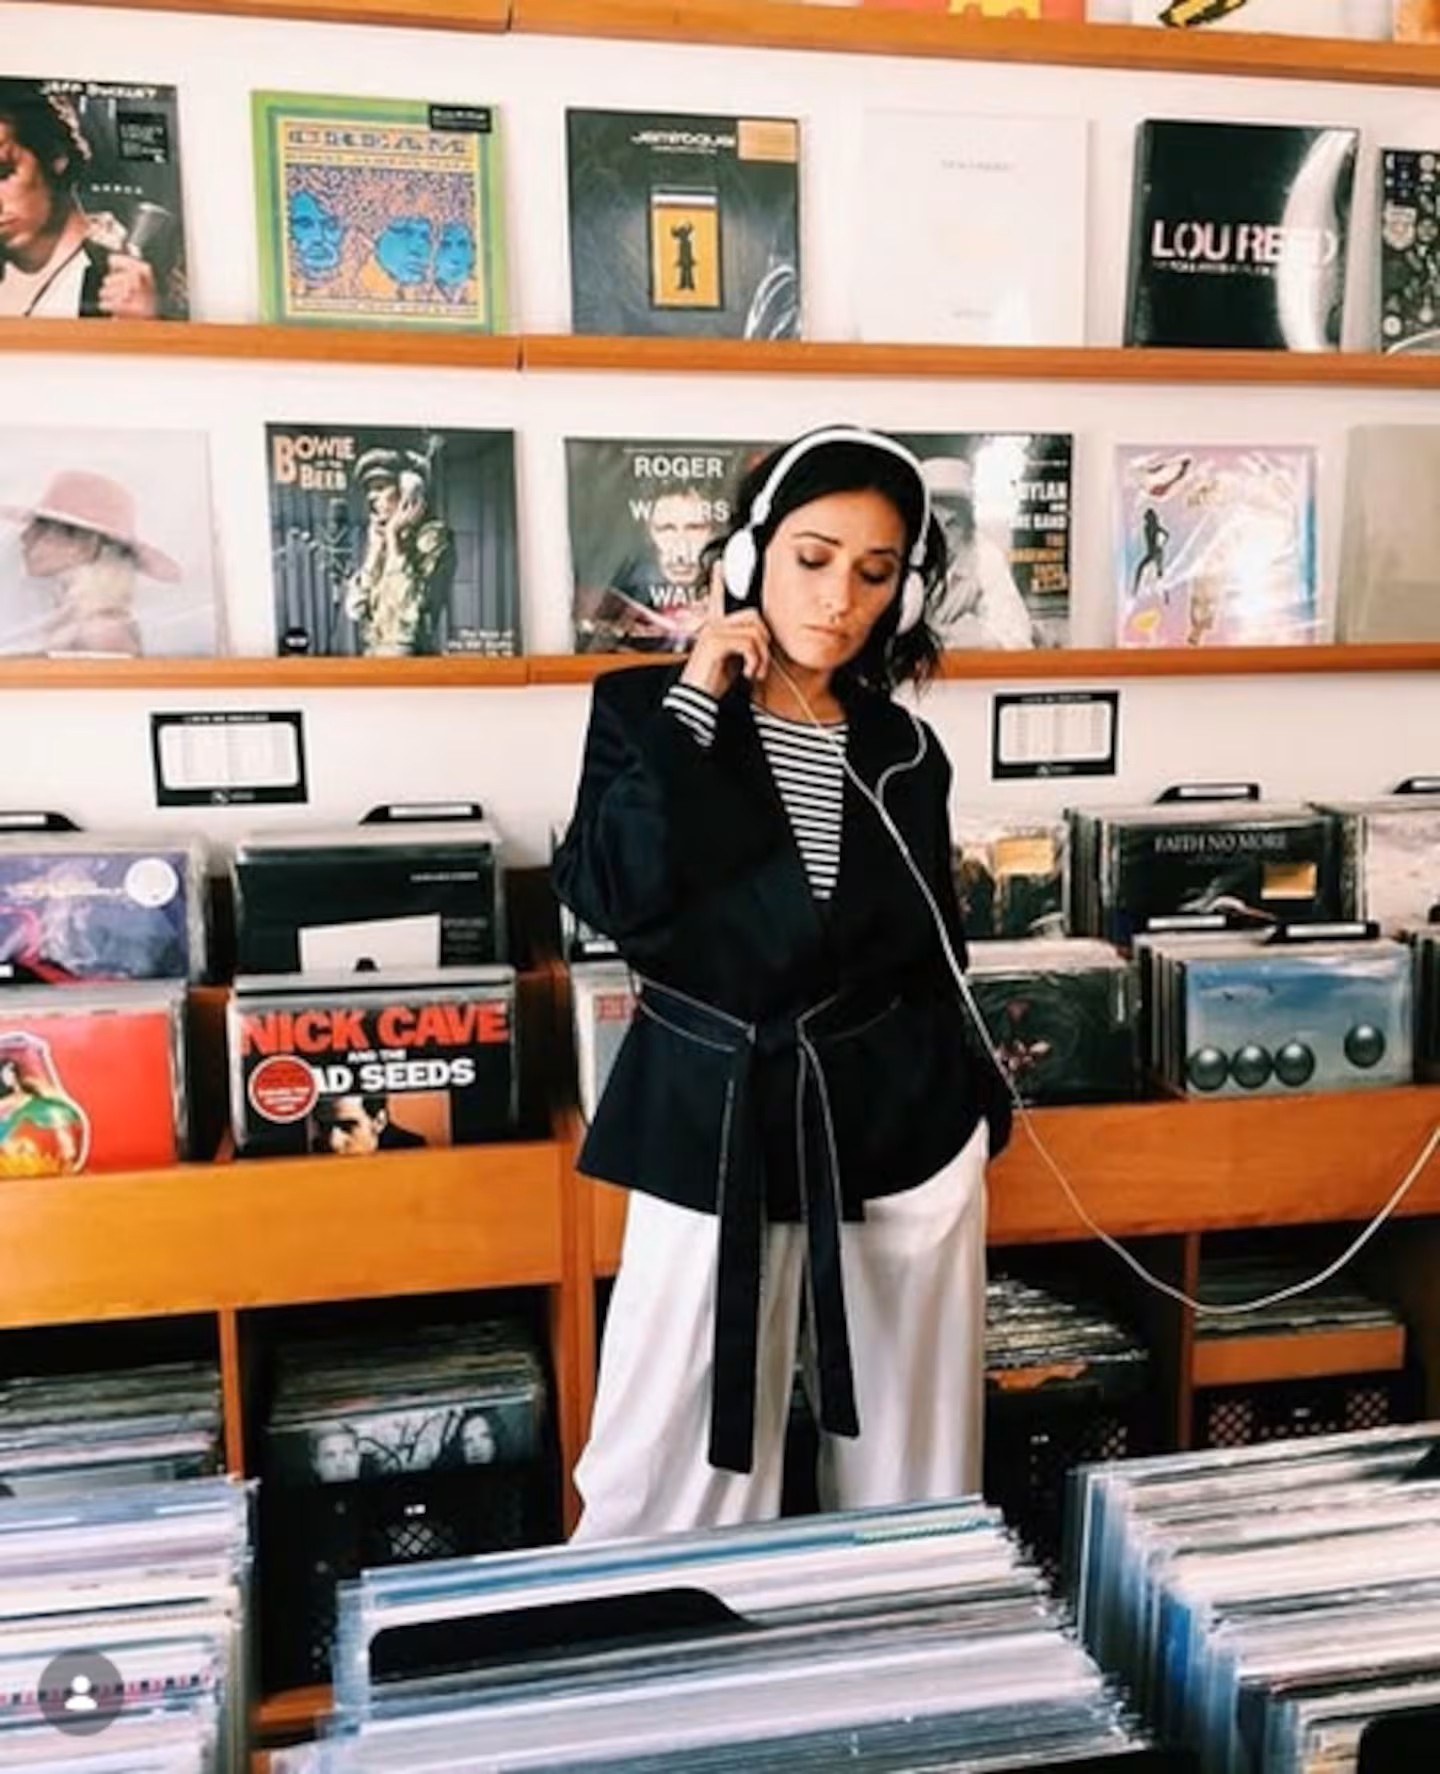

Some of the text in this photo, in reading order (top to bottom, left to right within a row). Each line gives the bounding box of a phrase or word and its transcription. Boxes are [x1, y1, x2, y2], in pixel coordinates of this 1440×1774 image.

[1152, 220, 1338, 264] LOU RED
[273, 434, 356, 484] BOWIE
[634, 456, 724, 478] ROGER
[1208, 833, 1236, 852] NO
[241, 1002, 511, 1055] NICK CAVE
[312, 1065, 353, 1093] AD
[360, 1058, 476, 1091] SEEDS
